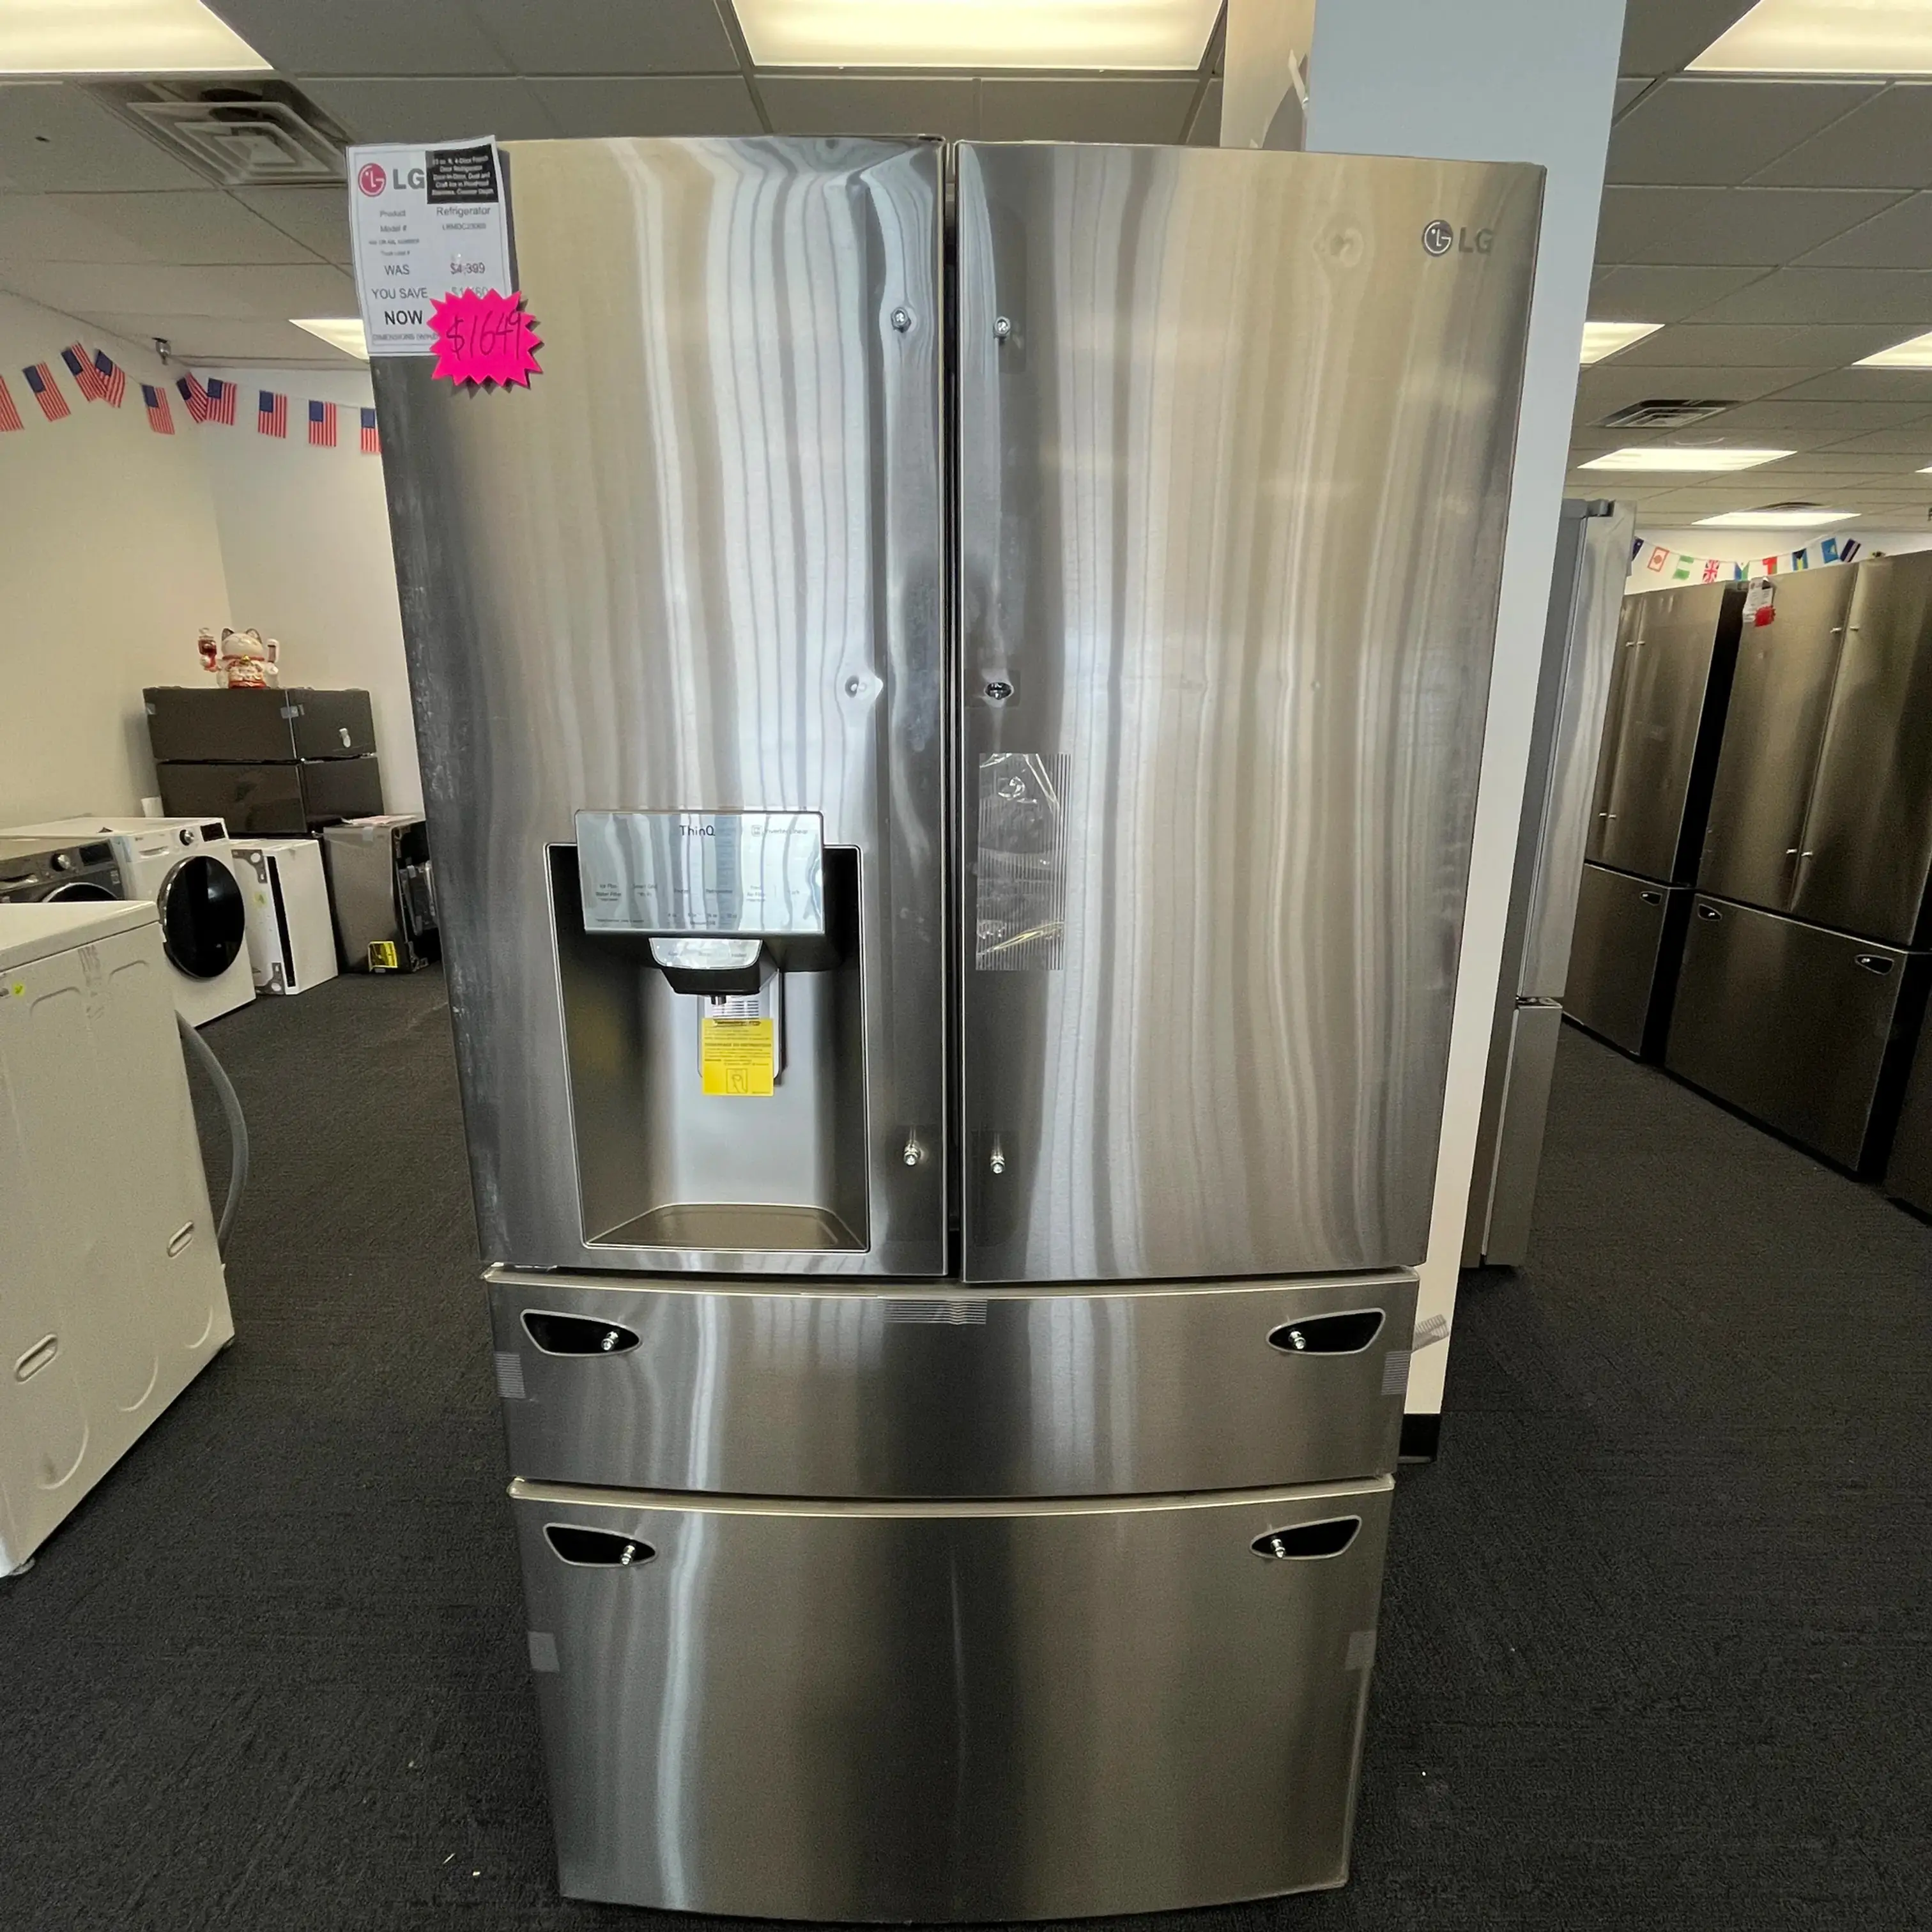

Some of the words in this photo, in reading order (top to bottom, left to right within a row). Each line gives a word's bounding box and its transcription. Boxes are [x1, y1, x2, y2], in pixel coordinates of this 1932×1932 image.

[393, 168, 425, 190] LG
[379, 210, 406, 218] Product
[436, 206, 491, 218] Refrigerator
[380, 224, 401, 233] Model
[1459, 226, 1494, 255] LG
[384, 264, 410, 276] WAS
[450, 262, 486, 276] $4,399
[371, 288, 396, 300] YOU
[399, 287, 429, 299] SAVE
[384, 310, 423, 325] NOW
[446, 309, 521, 360] $1649
[679, 825, 716, 836] ThinQ
